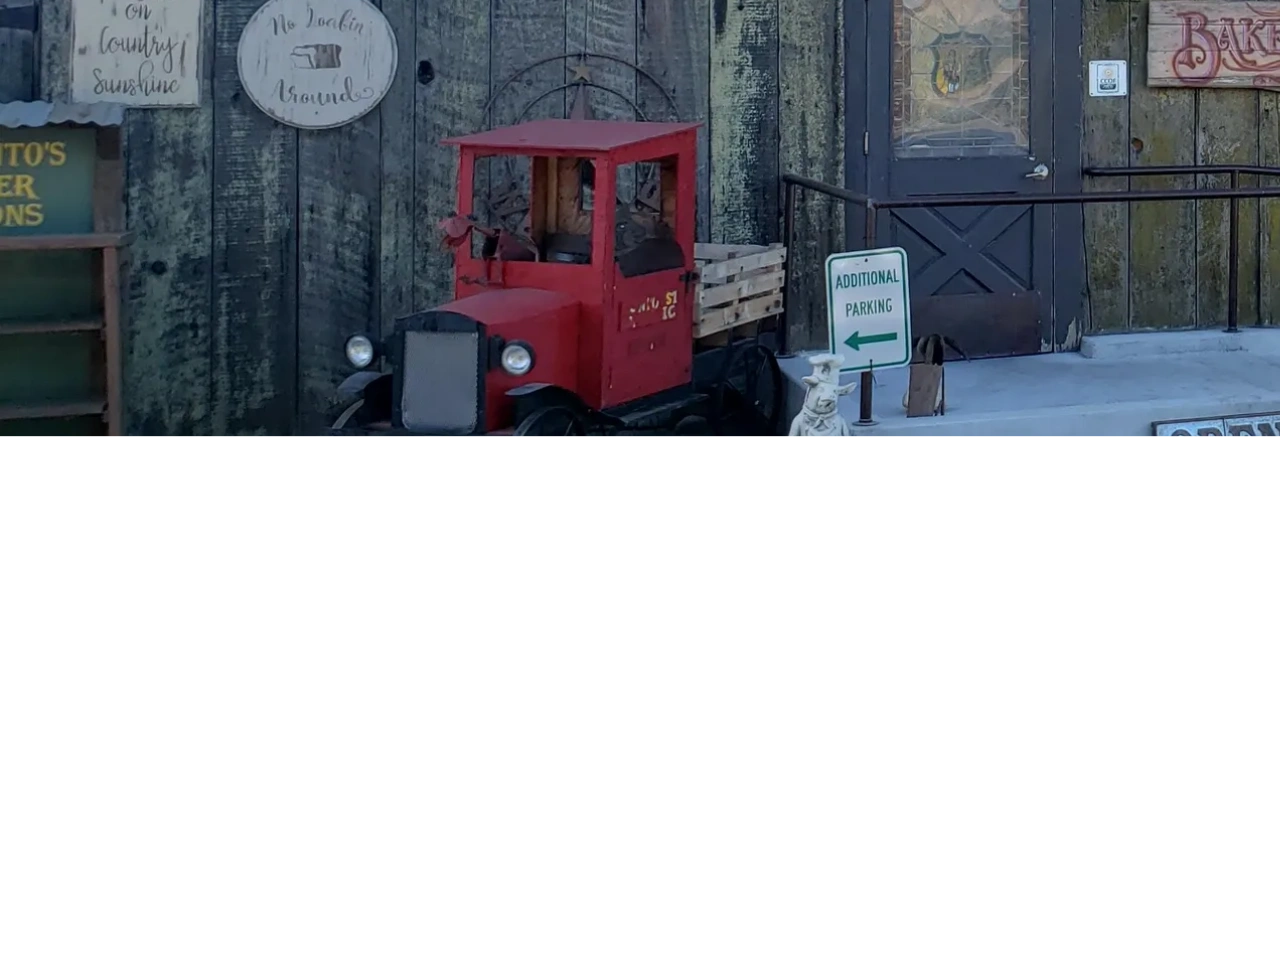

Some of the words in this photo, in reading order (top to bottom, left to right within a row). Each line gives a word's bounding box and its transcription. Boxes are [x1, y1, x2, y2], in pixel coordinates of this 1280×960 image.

[125, 3, 152, 20] on
[268, 13, 296, 36] No
[100, 24, 179, 74] Country
[92, 60, 180, 96] Sunshine
[0, 141, 66, 167] TO'S
[0, 203, 44, 227] NS
[835, 268, 900, 290] ADDITIONAL
[845, 298, 893, 318] PARKING
